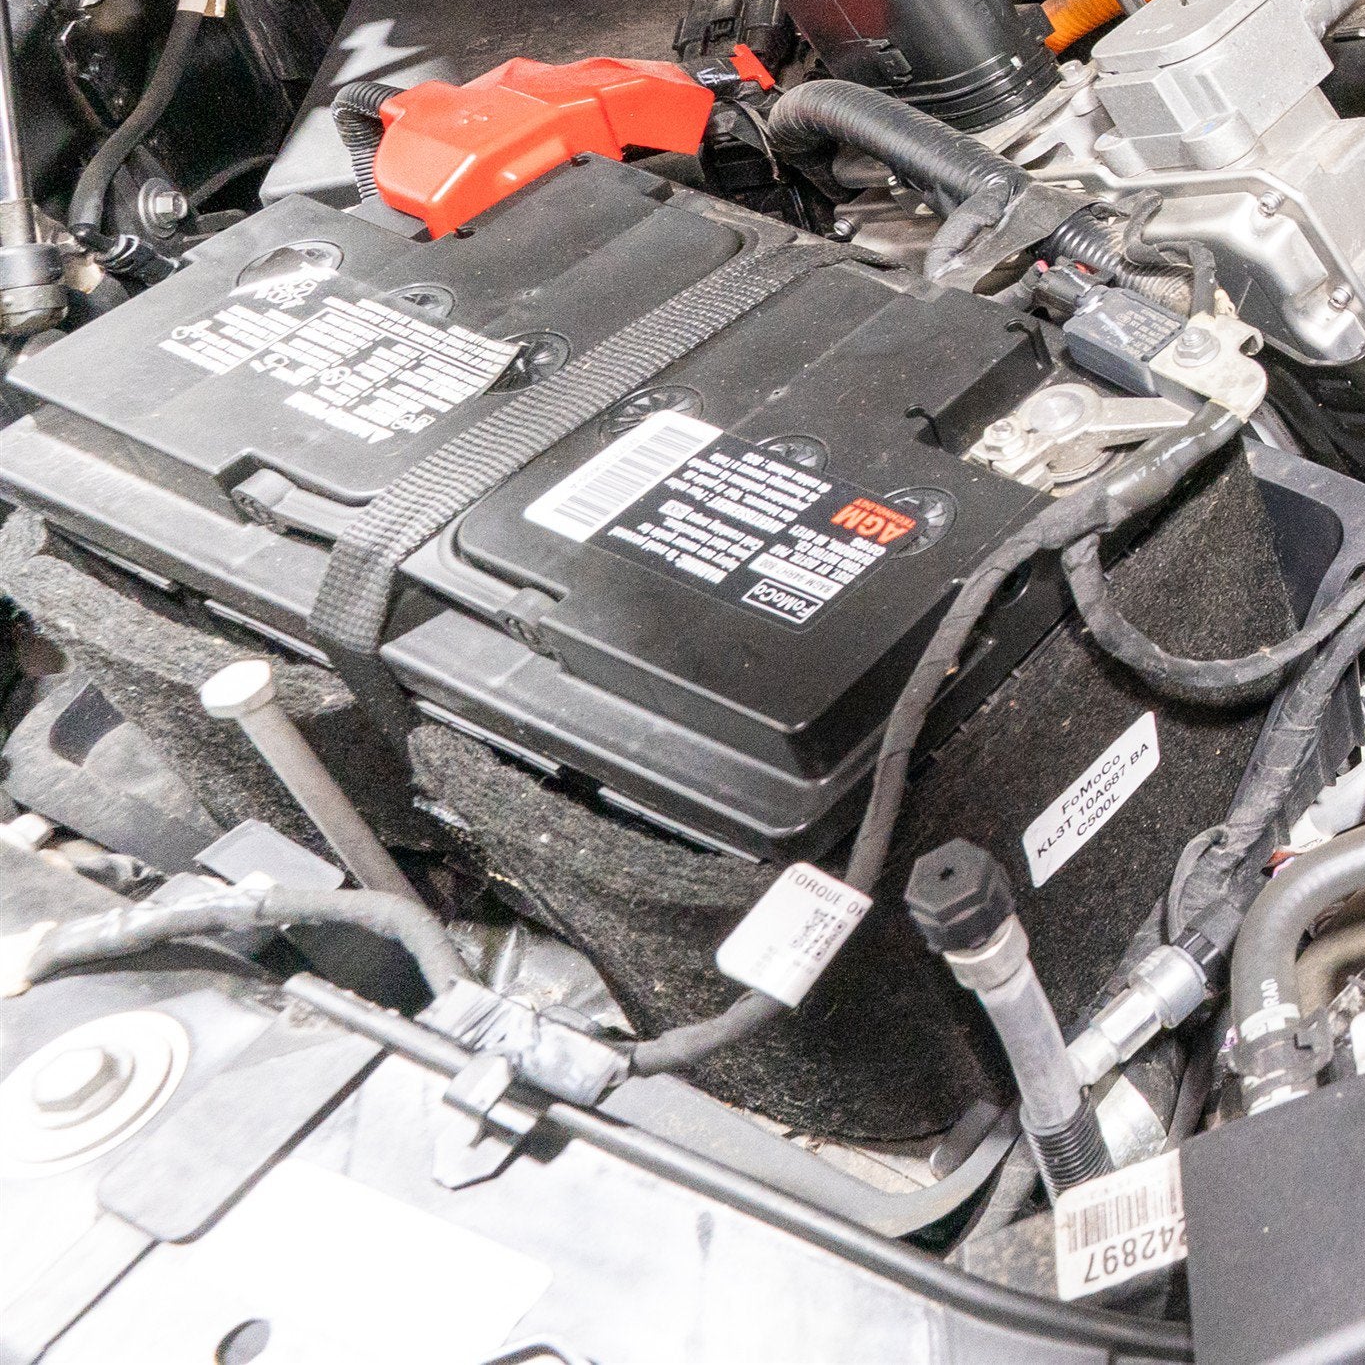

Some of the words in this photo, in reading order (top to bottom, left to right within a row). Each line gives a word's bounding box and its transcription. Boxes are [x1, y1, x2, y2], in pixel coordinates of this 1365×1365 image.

[828, 503, 909, 547] AGM
[850, 496, 918, 528] TECHNOLOGY
[749, 583, 816, 617] FoMoCo
[1037, 816, 1074, 858] KL3T
[1079, 764, 1127, 817] 10A687
[1130, 743, 1149, 765] BA
[1061, 755, 1121, 815] FoMoCo
[1076, 795, 1121, 837] C500L
[787, 866, 845, 906] TORQUE
